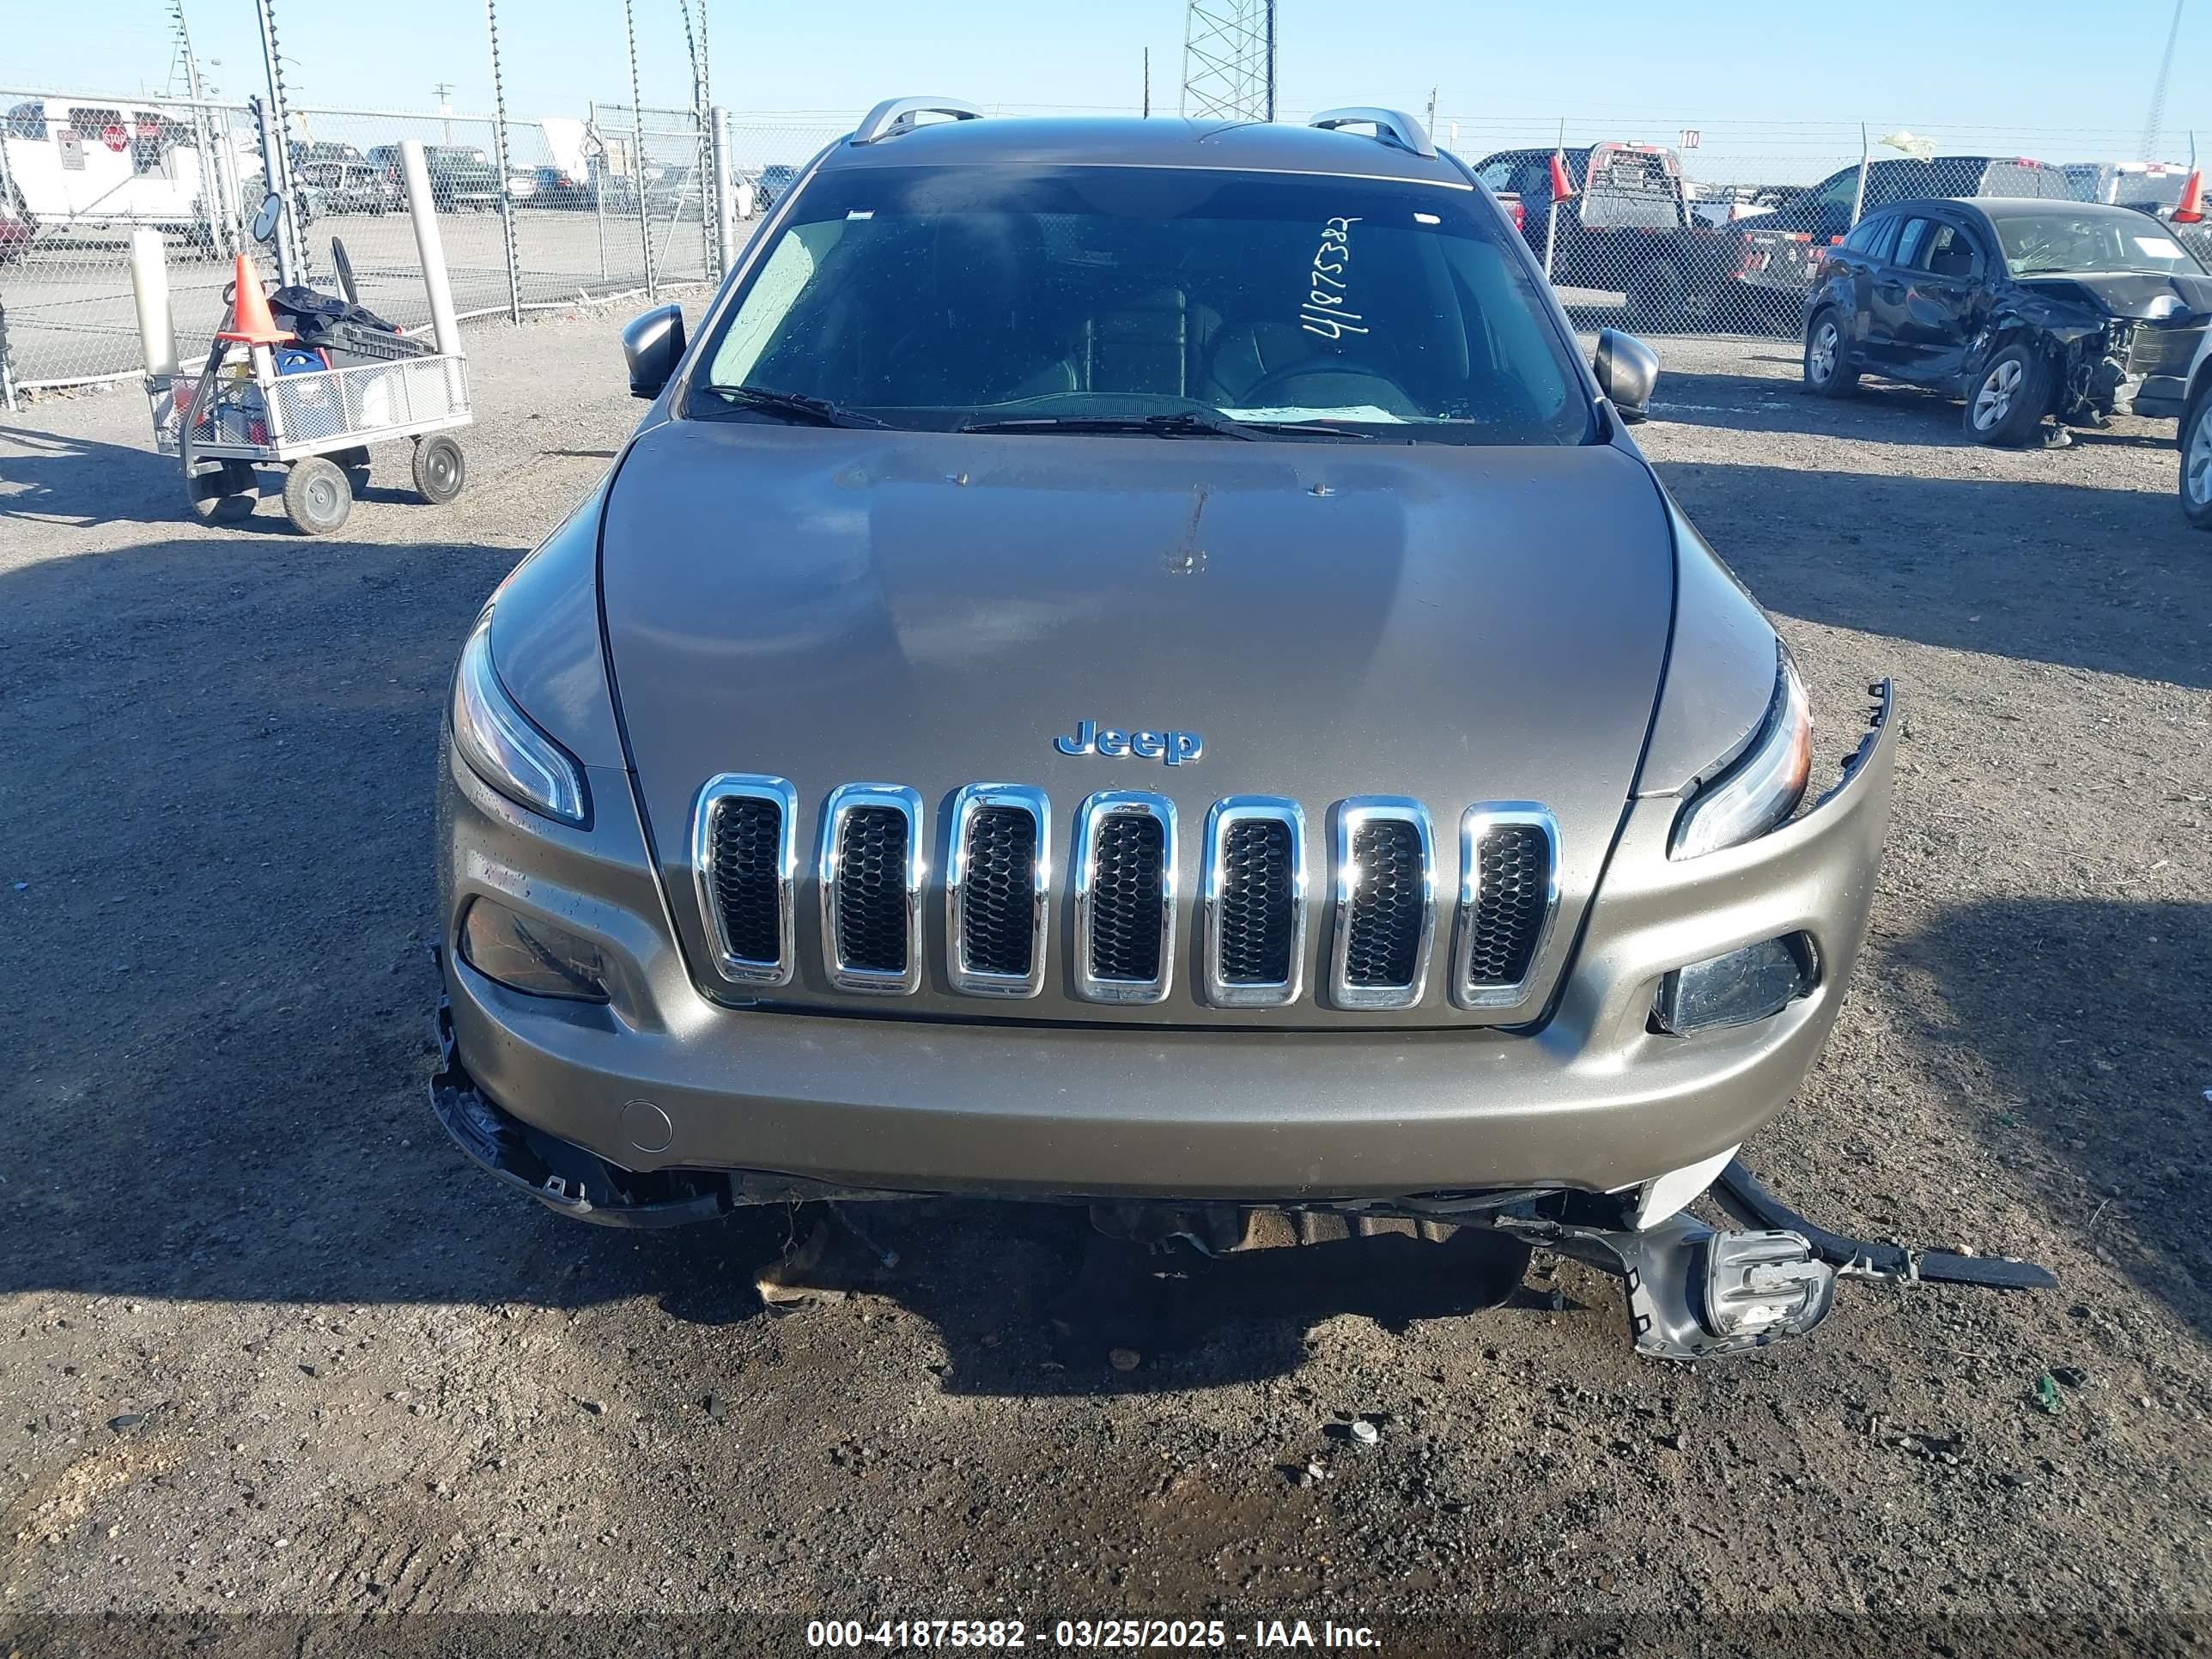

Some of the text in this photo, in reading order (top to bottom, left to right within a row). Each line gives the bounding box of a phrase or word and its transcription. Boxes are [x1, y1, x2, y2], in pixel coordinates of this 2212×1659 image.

[104, 134, 126, 144] STOP
[1299, 216, 1370, 339] 41875382
[1054, 720, 1203, 767] Jeep
